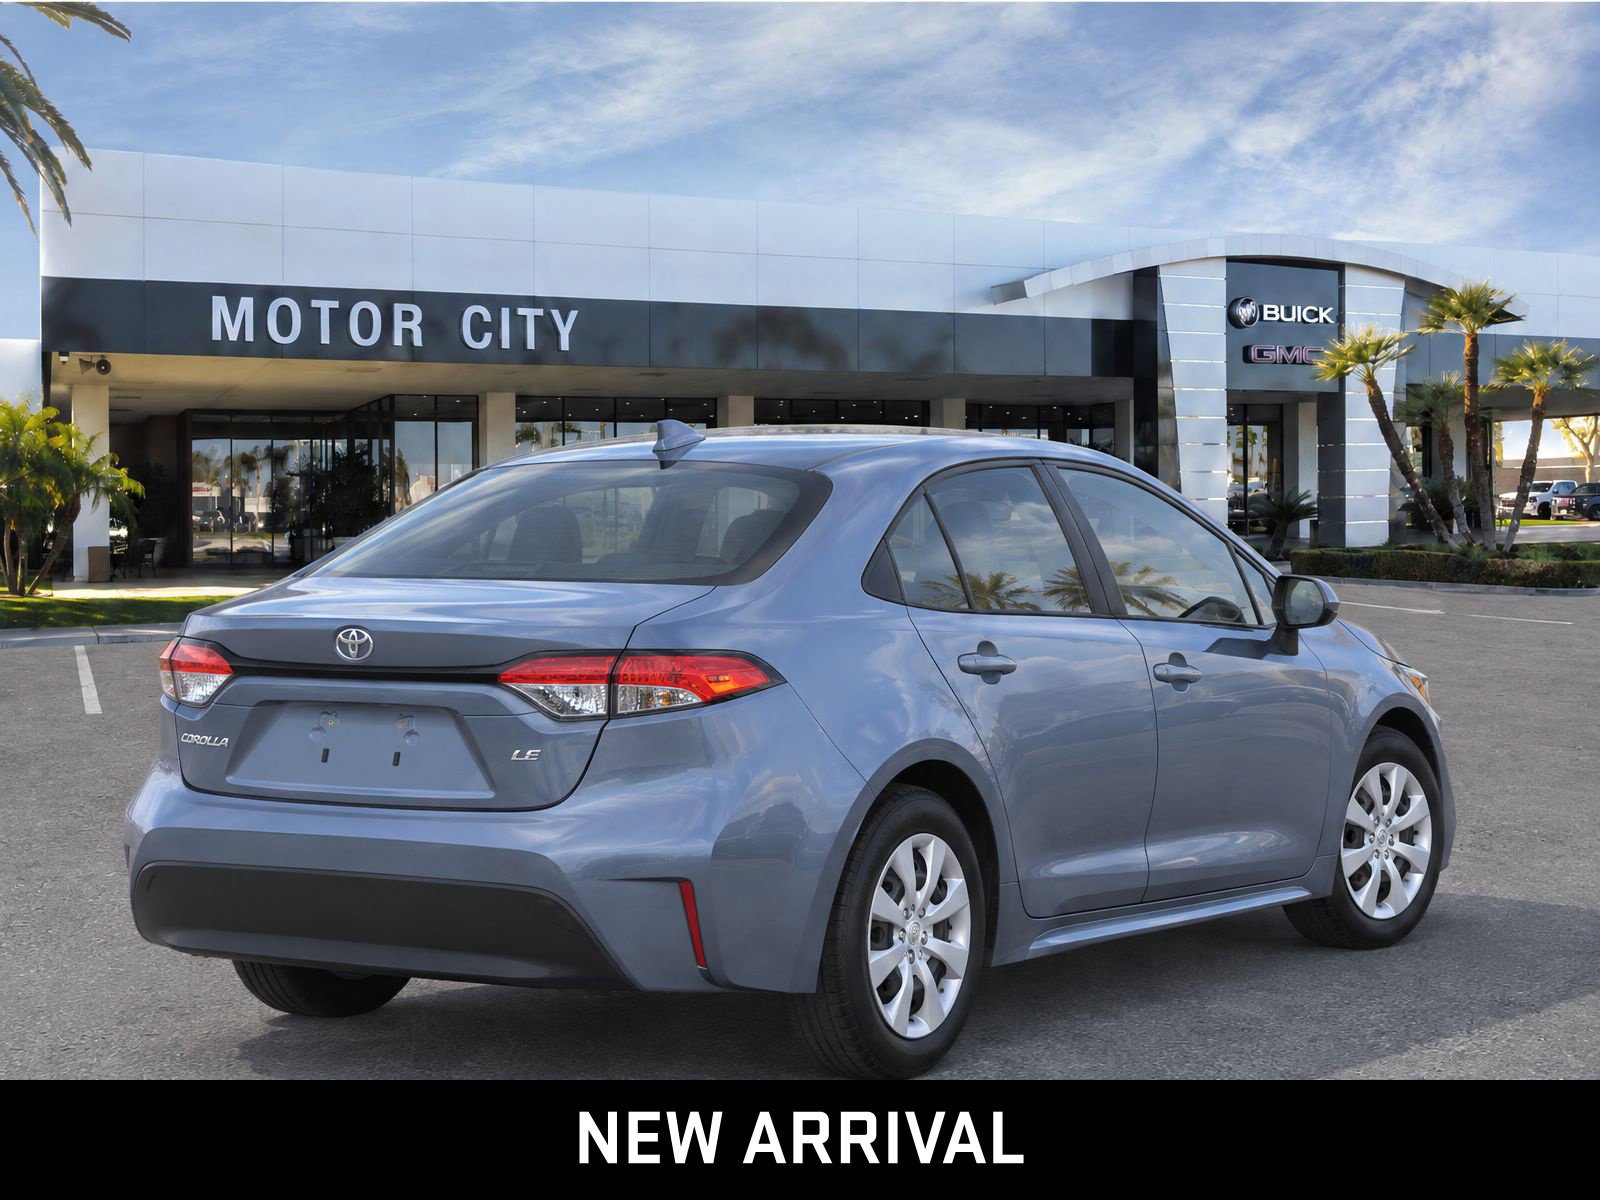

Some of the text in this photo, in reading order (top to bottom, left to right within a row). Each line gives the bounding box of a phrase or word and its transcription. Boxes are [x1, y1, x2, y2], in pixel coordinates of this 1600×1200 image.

[211, 295, 579, 352] MOTOR CITY
[1262, 304, 1335, 324] BUICK
[1250, 344, 1324, 364] GMC
[181, 733, 229, 748] COROLLA
[511, 749, 541, 761] LE
